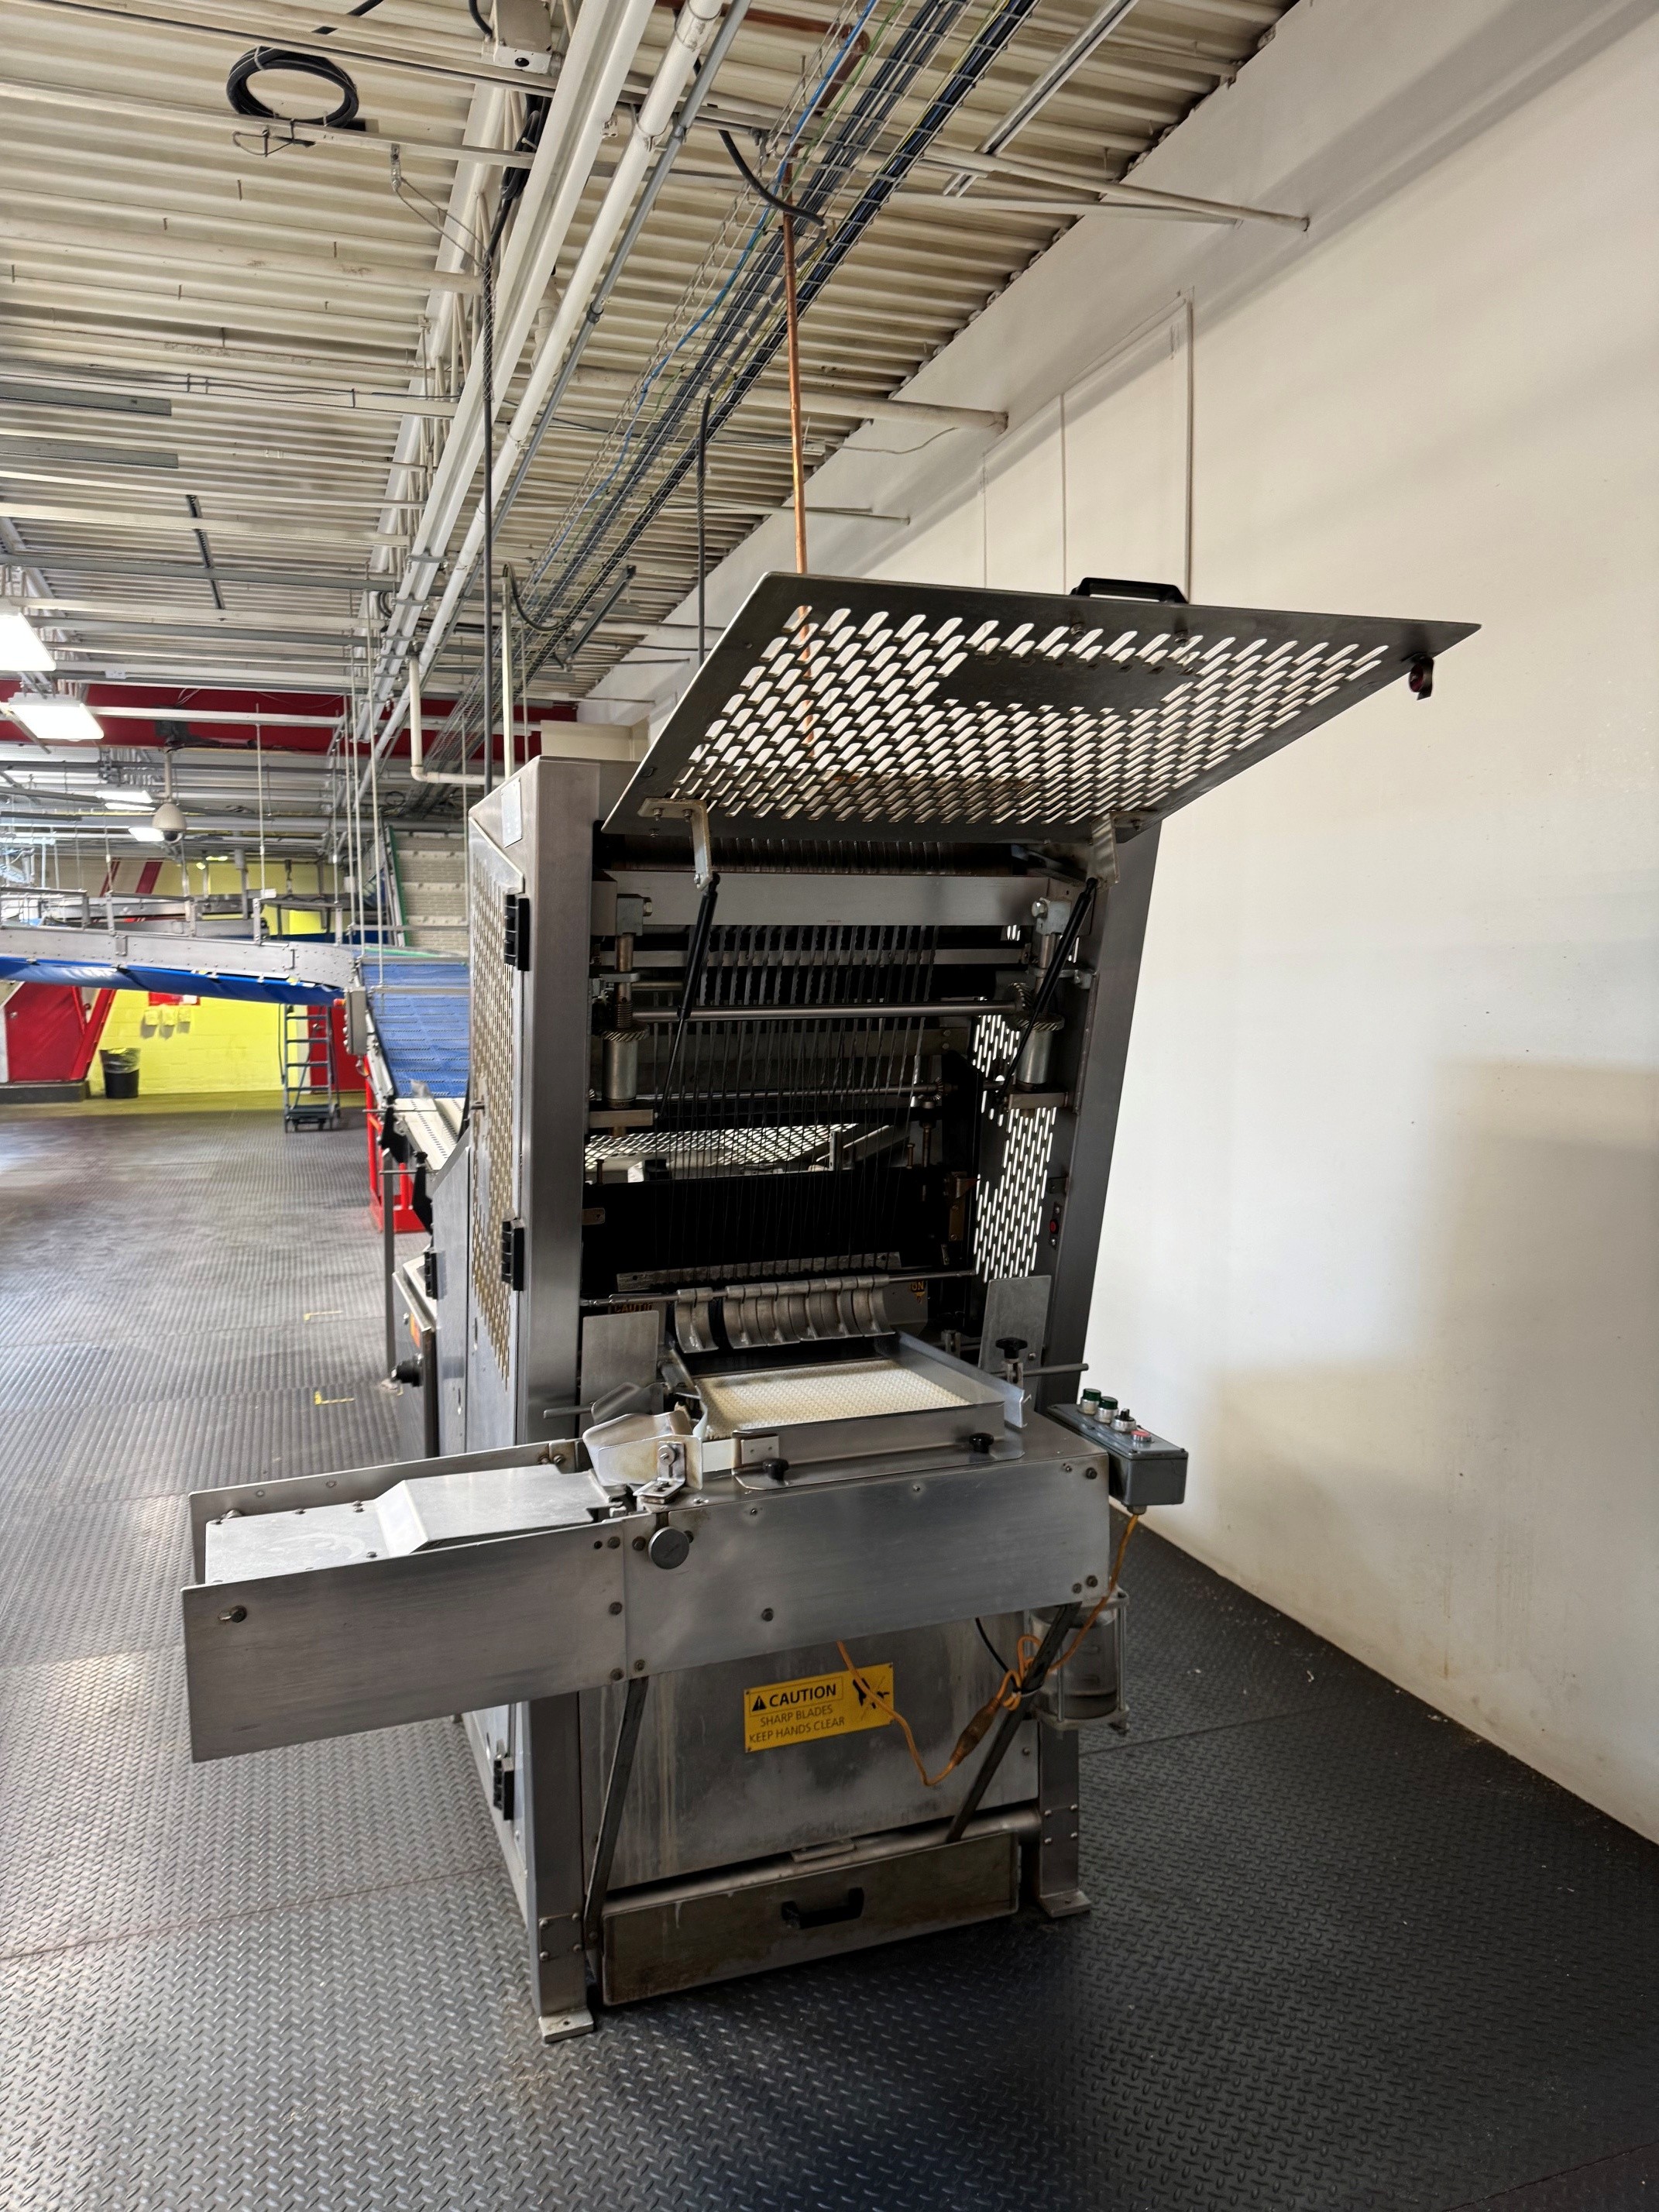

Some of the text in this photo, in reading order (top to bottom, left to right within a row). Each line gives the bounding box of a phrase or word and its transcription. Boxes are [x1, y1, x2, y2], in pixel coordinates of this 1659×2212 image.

[769, 1684, 836, 1707] CAUTION
[760, 1705, 833, 1727] SHARP BLADES
[749, 1717, 845, 1743] KEEP HANDS CLEAR
